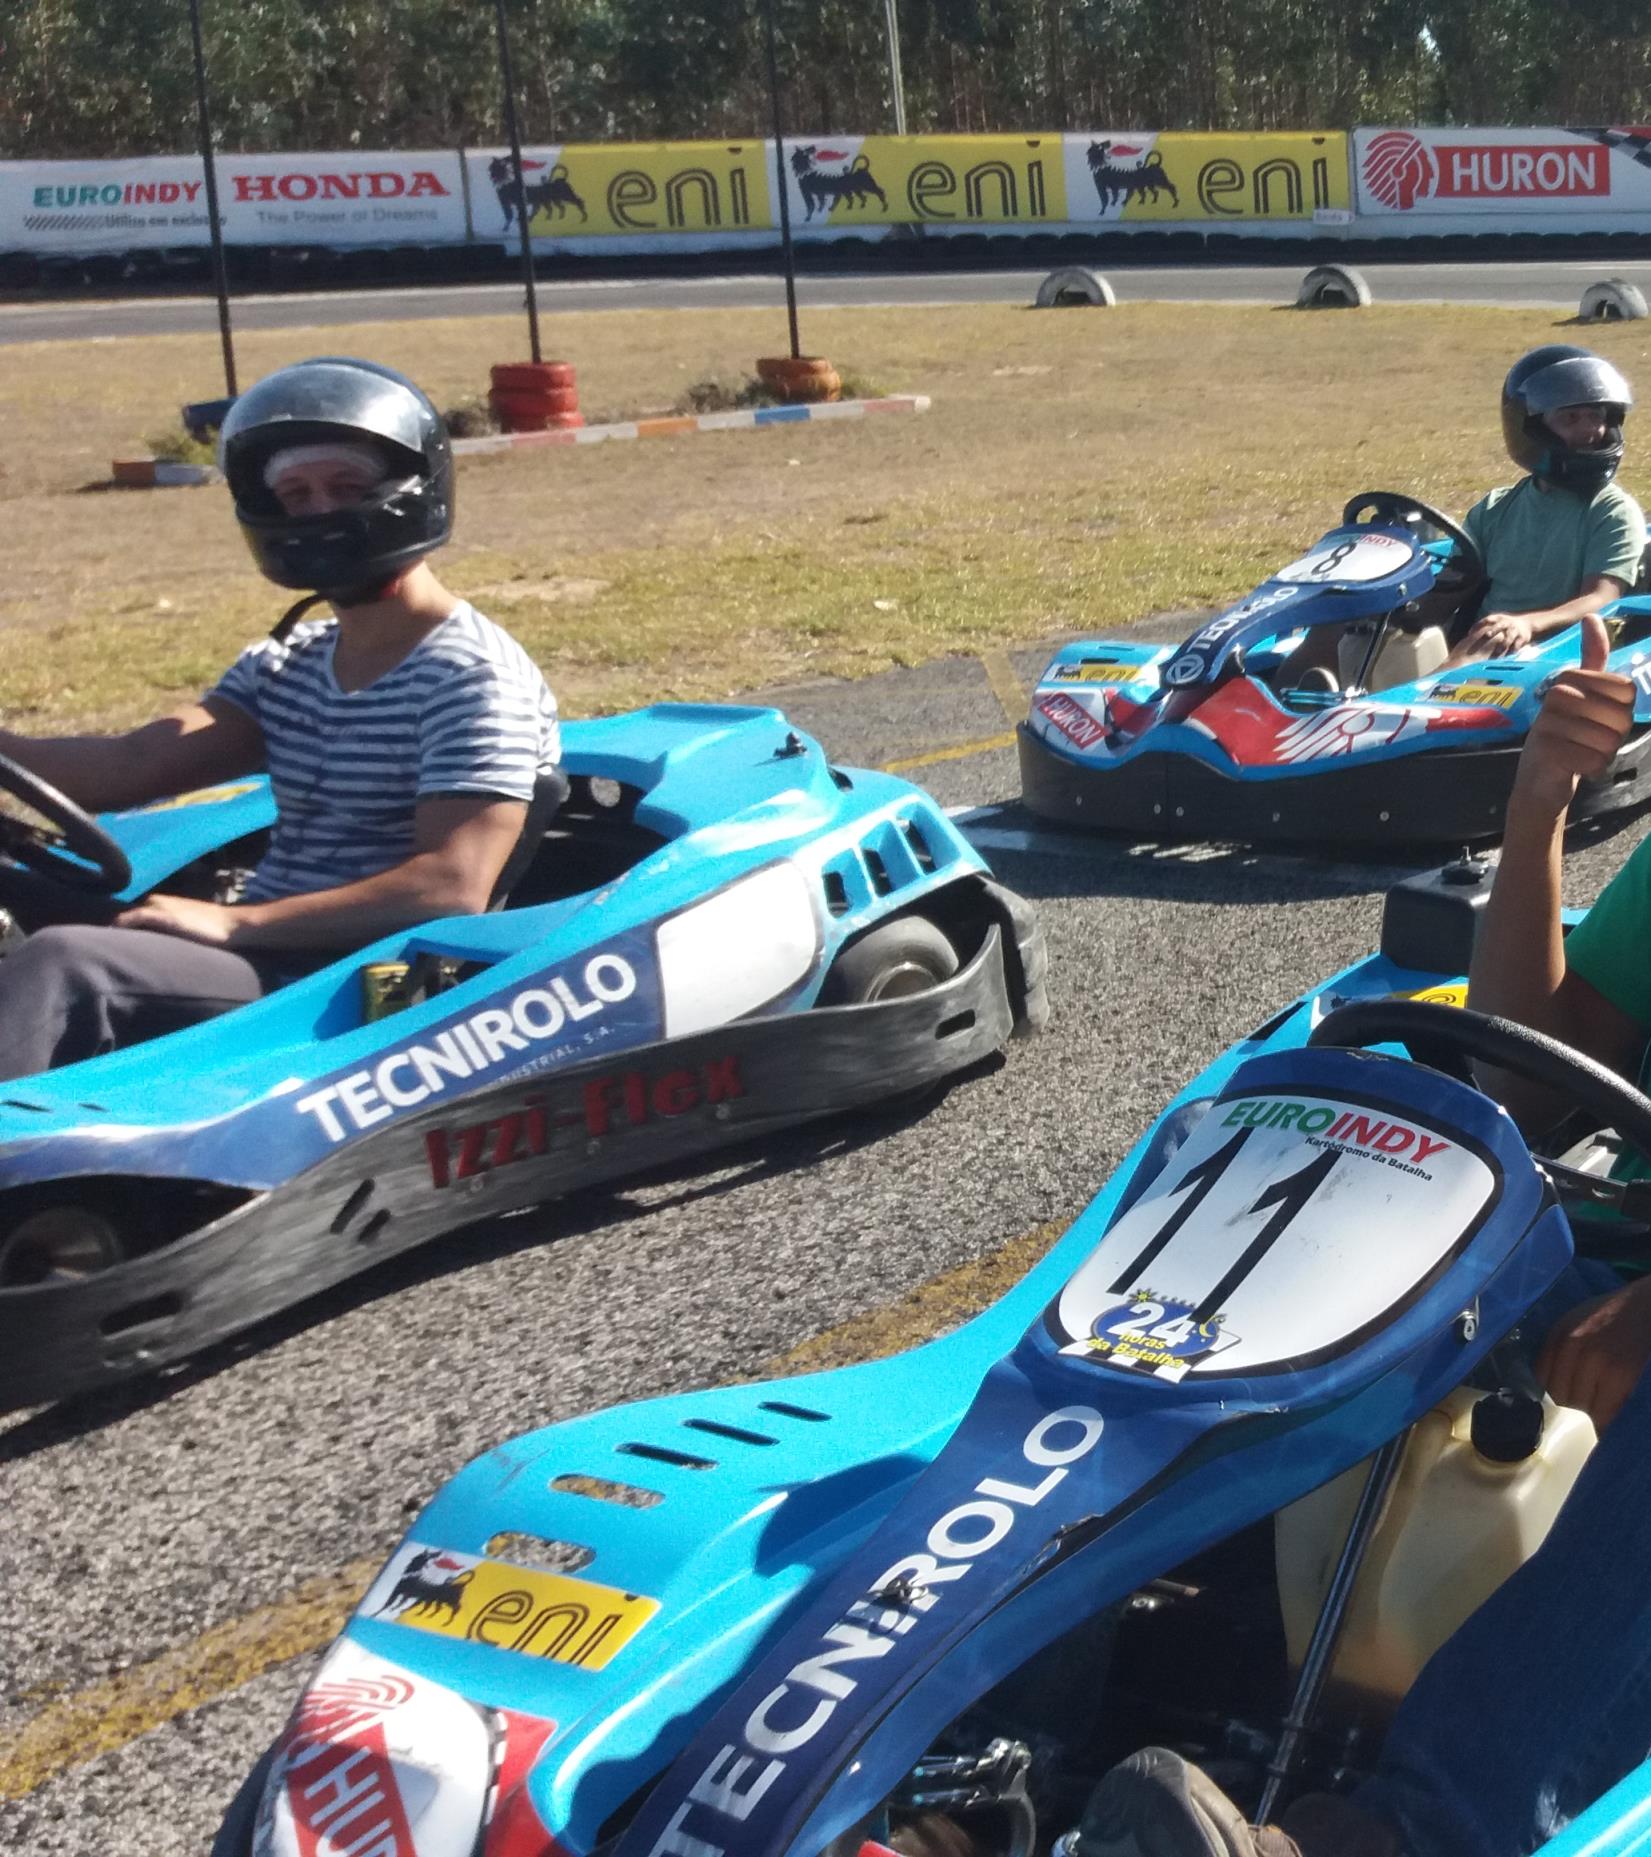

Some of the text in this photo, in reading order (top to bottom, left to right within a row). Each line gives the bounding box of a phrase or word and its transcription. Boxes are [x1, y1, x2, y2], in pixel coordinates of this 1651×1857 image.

[232, 171, 451, 201] HONDA
[607, 147, 748, 228] eni
[907, 139, 1046, 218] eni
[1198, 136, 1329, 216] eni
[1452, 148, 1596, 192] HURON
[33, 180, 202, 208] EUROINDY
[256, 207, 438, 224] The Power of Dreams
[1311, 541, 1358, 576] 8
[1044, 697, 1101, 743] HURON
[299, 953, 637, 1143] TECNIROLO
[1220, 1101, 1452, 1164] EUROINDY
[1305, 1136, 1434, 1182] Kartódromo da Batalha
[1107, 1127, 1345, 1323] 11
[1106, 1301, 1198, 1348] 24
[1119, 1331, 1167, 1350] horas
[1087, 1337, 1186, 1369] da Batalha
[467, 1589, 638, 1666] eni
